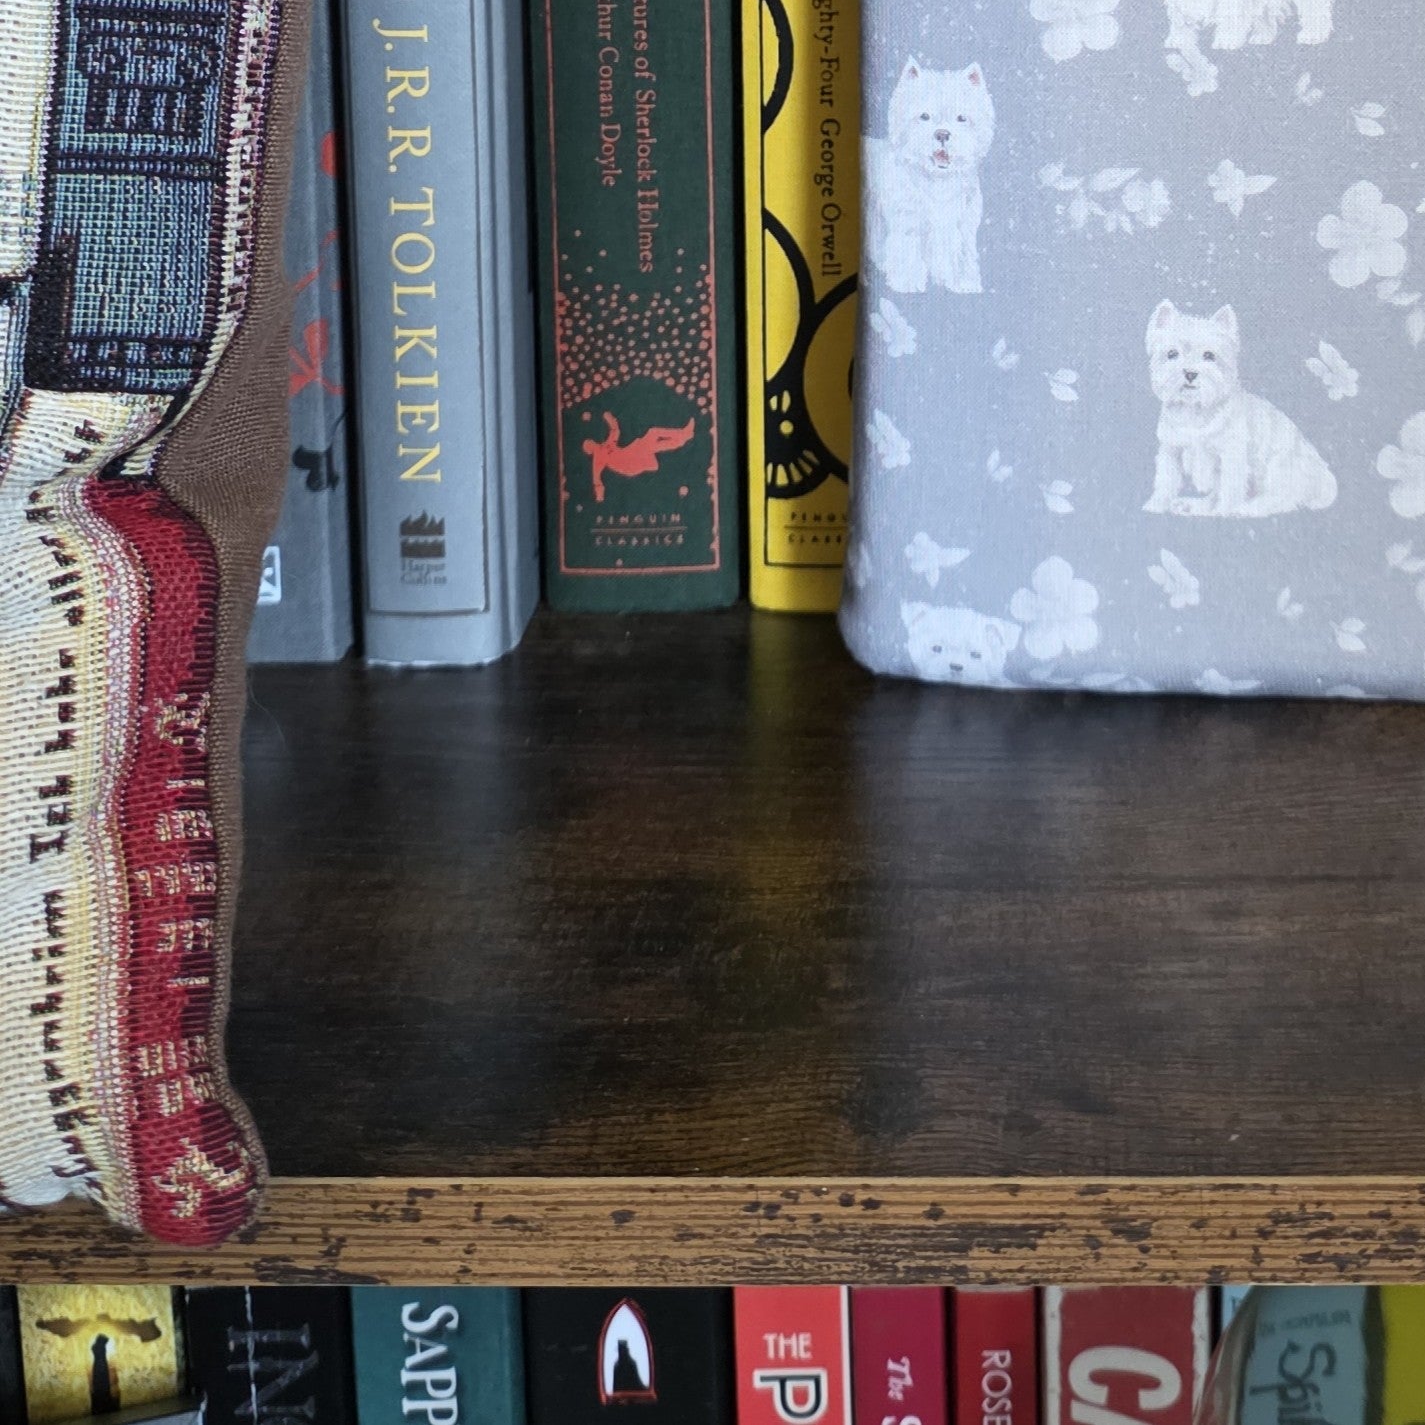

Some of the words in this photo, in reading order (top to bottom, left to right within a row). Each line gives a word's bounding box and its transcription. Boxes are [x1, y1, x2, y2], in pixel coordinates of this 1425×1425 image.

[598, 45, 620, 118] Conan
[634, 56, 657, 81] of
[594, 122, 622, 187] Doyle
[635, 88, 658, 182] Sherlock
[814, 118, 842, 198] George
[637, 186, 660, 274] Holmes
[820, 203, 843, 277] Orwell
[389, 186, 442, 484] TOLKIEN
[595, 534, 684, 546] CLASSICS
[596, 513, 682, 525] PENGUIN
[763, 1332, 813, 1360] THE
[887, 1355, 914, 1402] The
